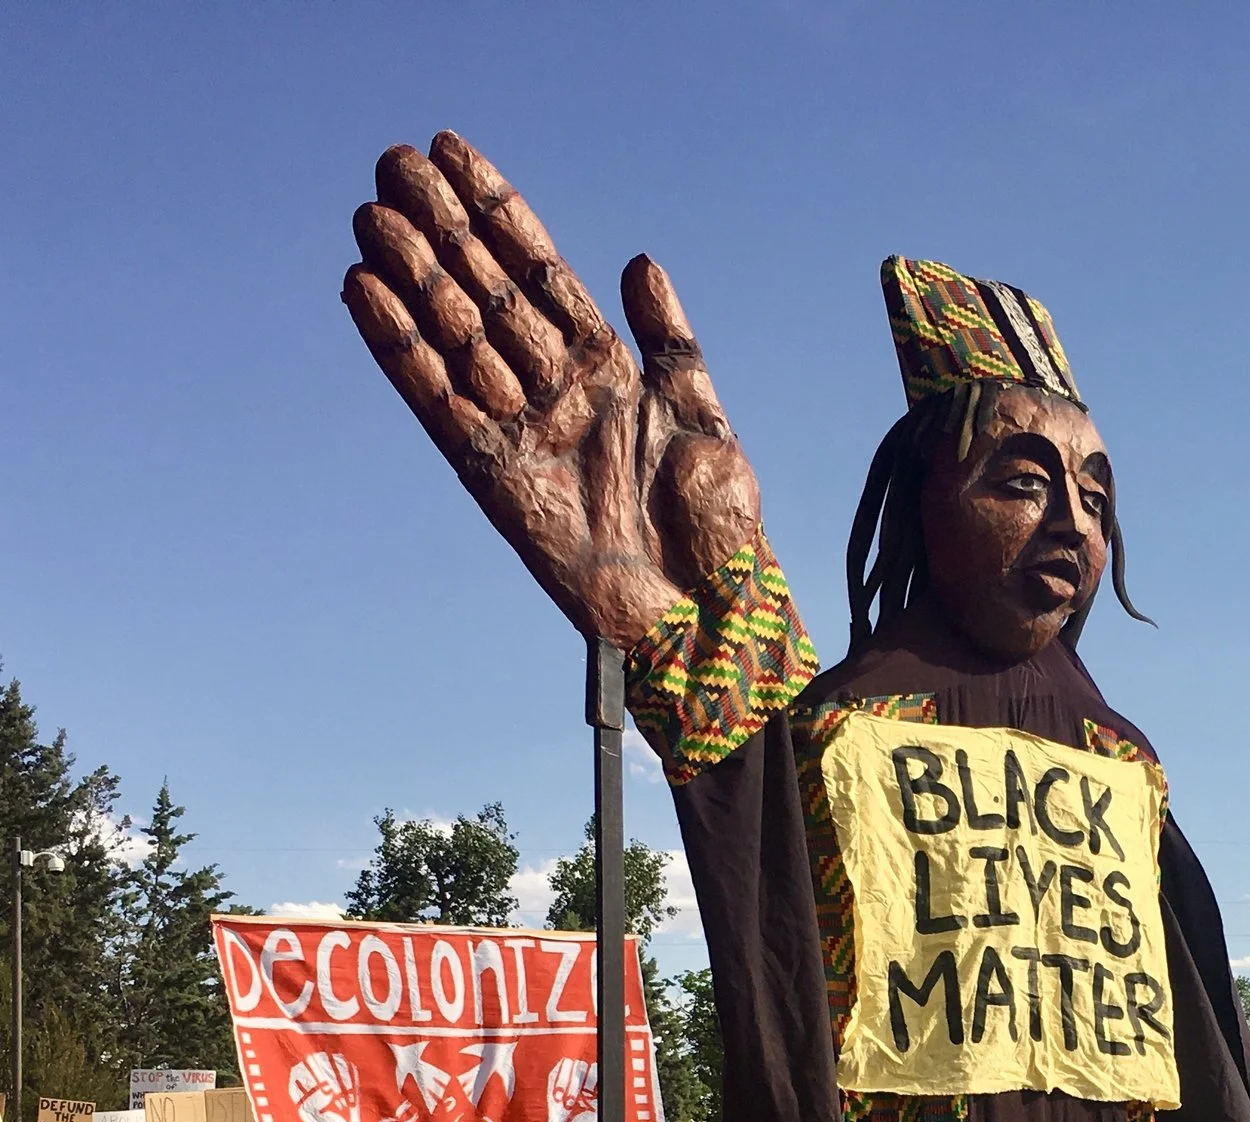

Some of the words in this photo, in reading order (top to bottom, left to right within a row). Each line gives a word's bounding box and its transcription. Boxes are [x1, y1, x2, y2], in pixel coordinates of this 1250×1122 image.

[893, 746, 1125, 862] BLACK
[914, 846, 1142, 958] LIVES
[888, 946, 1172, 1057] MATTER
[40, 1099, 94, 1115] DEFUND
[132, 1072, 163, 1083] STOP
[182, 1072, 214, 1083] VIRUS
[55, 1112, 75, 1122] THE
